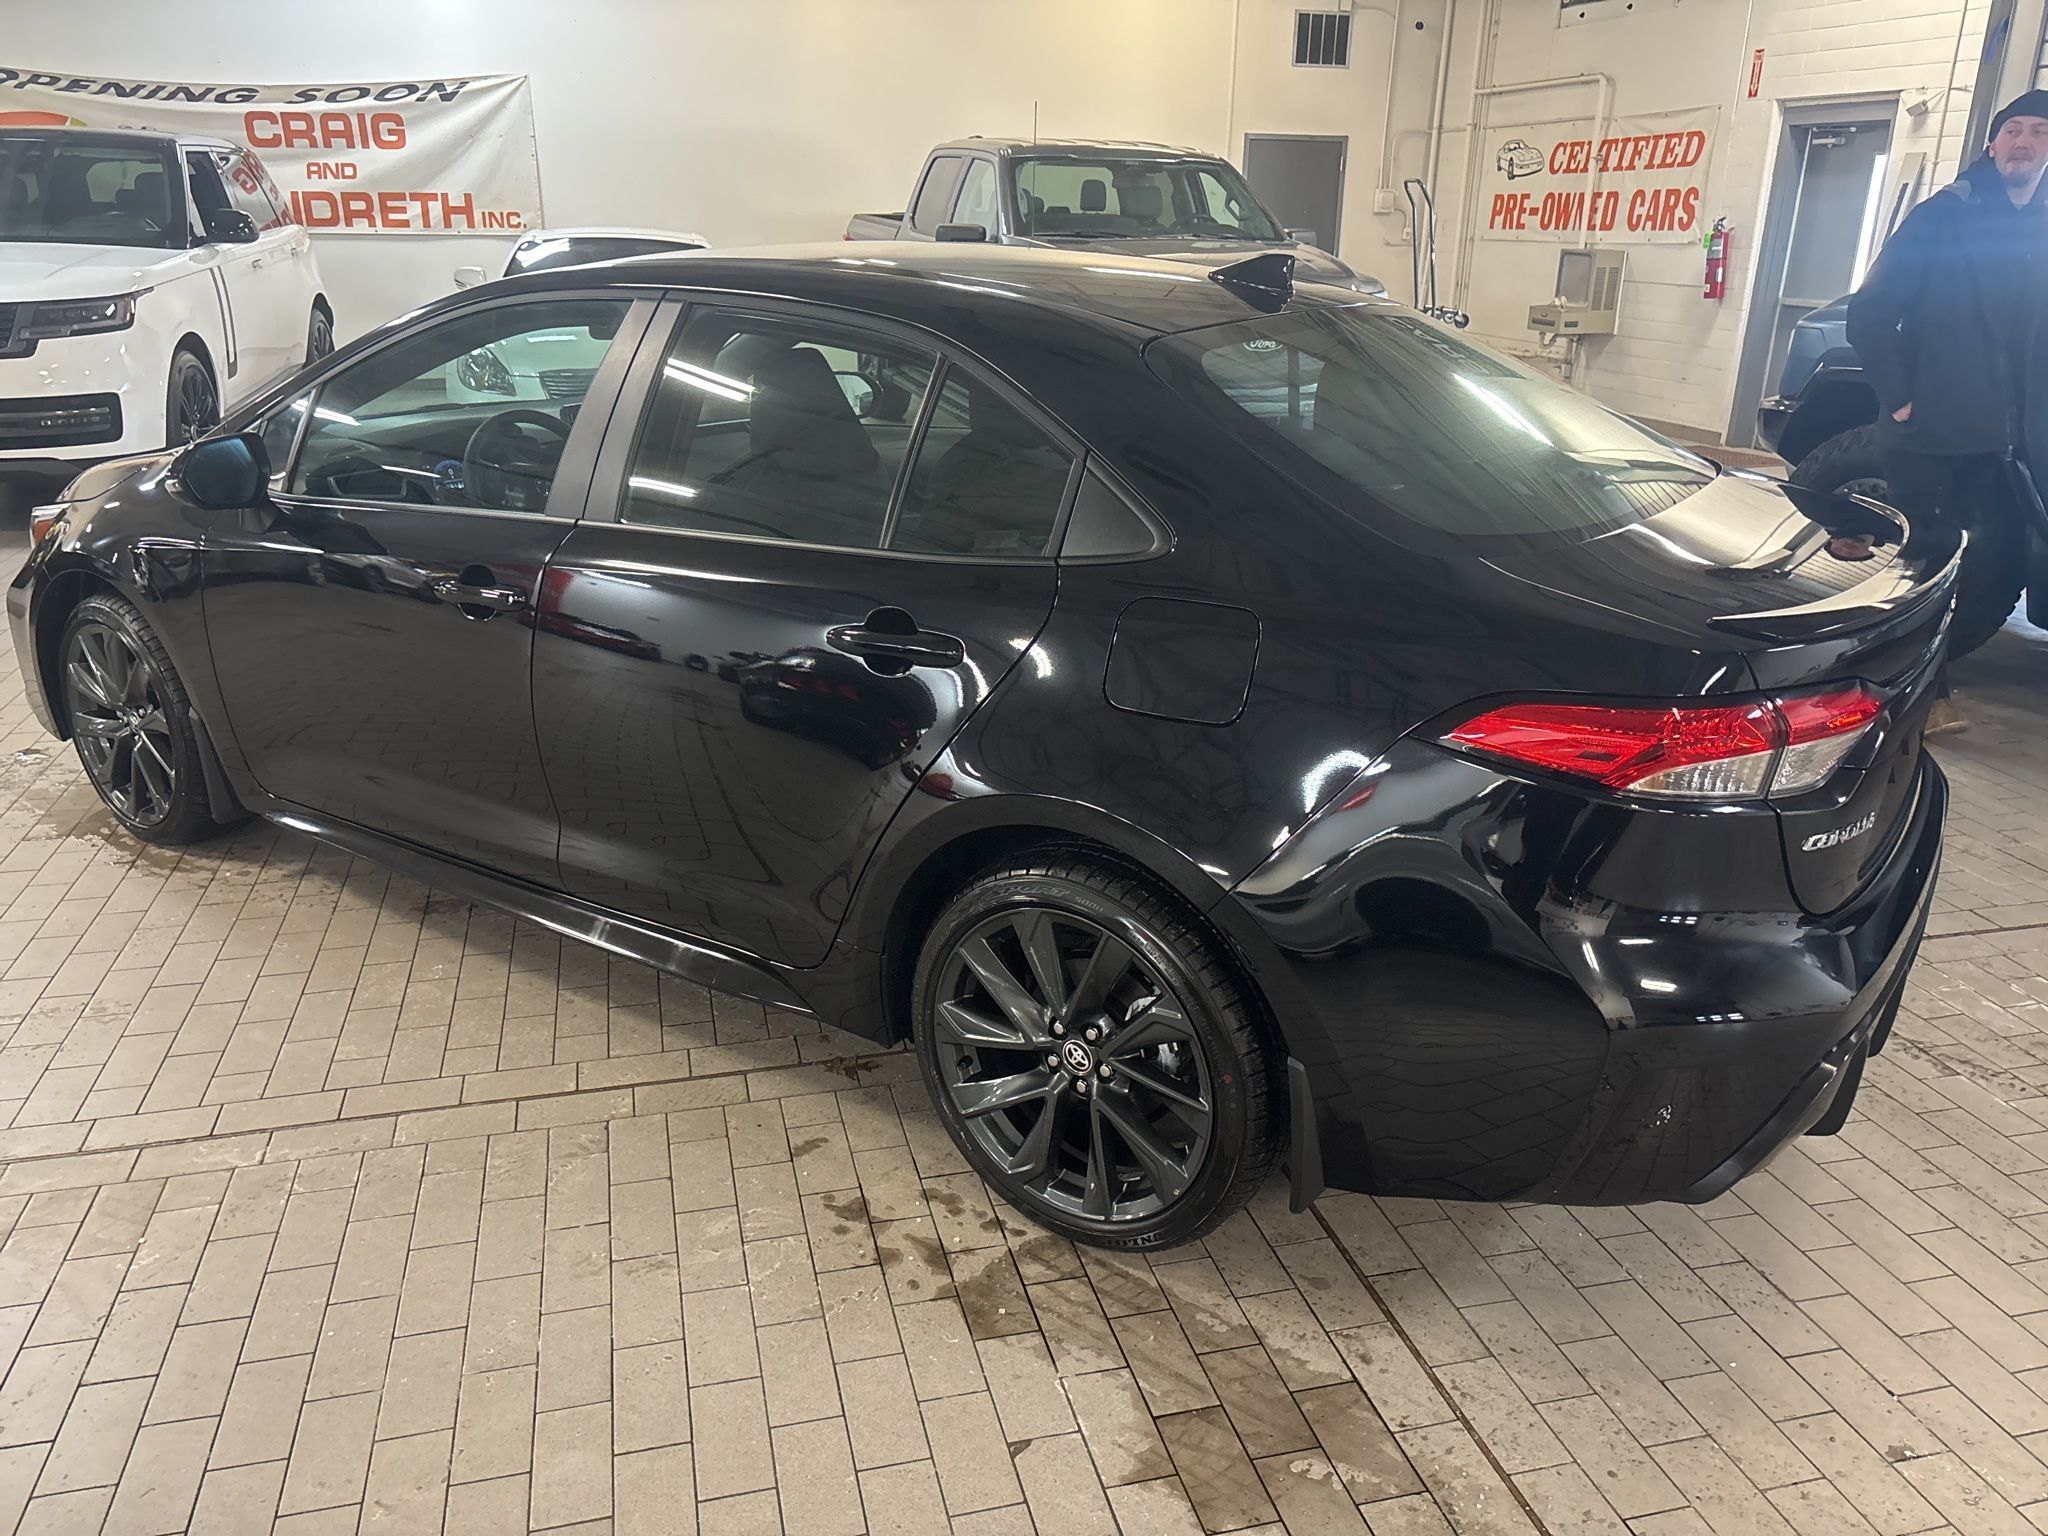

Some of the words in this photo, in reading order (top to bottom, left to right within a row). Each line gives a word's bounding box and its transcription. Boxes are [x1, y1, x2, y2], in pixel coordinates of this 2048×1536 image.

[284, 81, 470, 104] SOON
[244, 111, 407, 150] CRAIG
[306, 162, 357, 180] AND
[481, 211, 527, 228] INC.
[1489, 190, 1619, 232] PRE-OWNED
[1626, 186, 1699, 232] CARS
